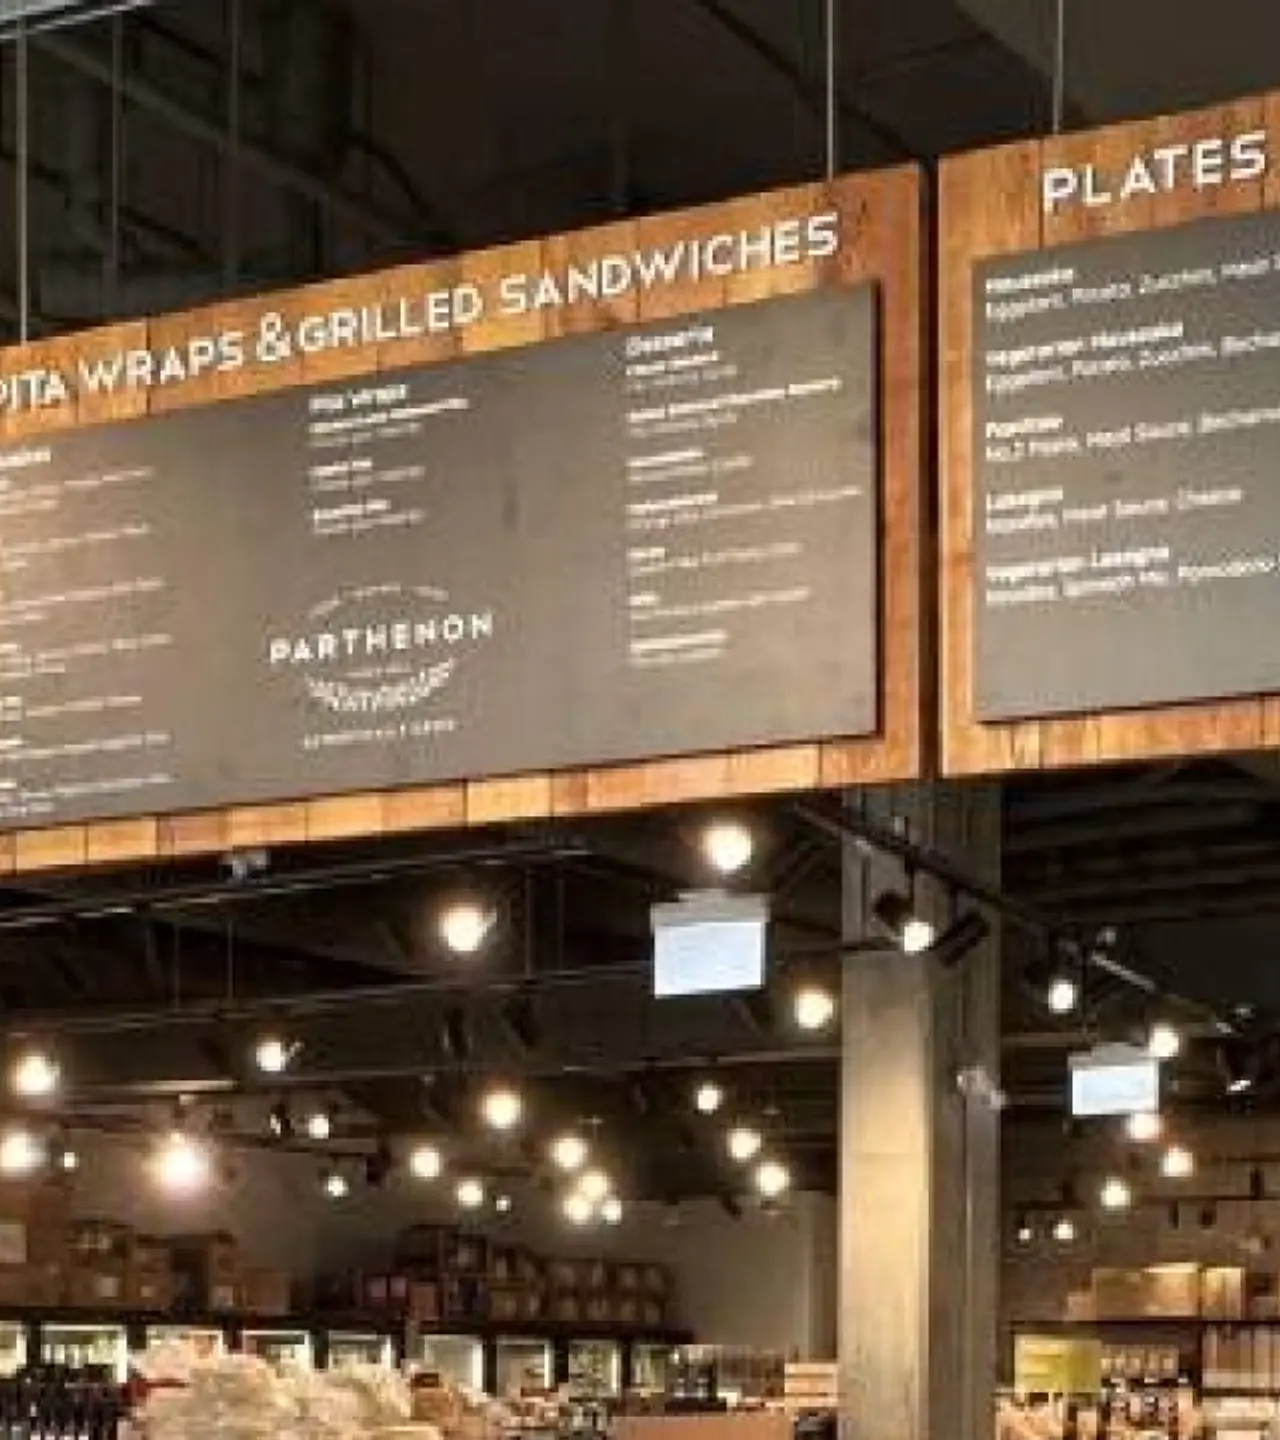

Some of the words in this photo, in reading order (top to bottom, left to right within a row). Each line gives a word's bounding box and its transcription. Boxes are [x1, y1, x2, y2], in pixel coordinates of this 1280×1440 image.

[1043, 130, 1266, 214] PLATES
[77, 327, 244, 398] WRAPS
[499, 212, 840, 315] SANDWICHES
[270, 610, 494, 665] PARTHENON
